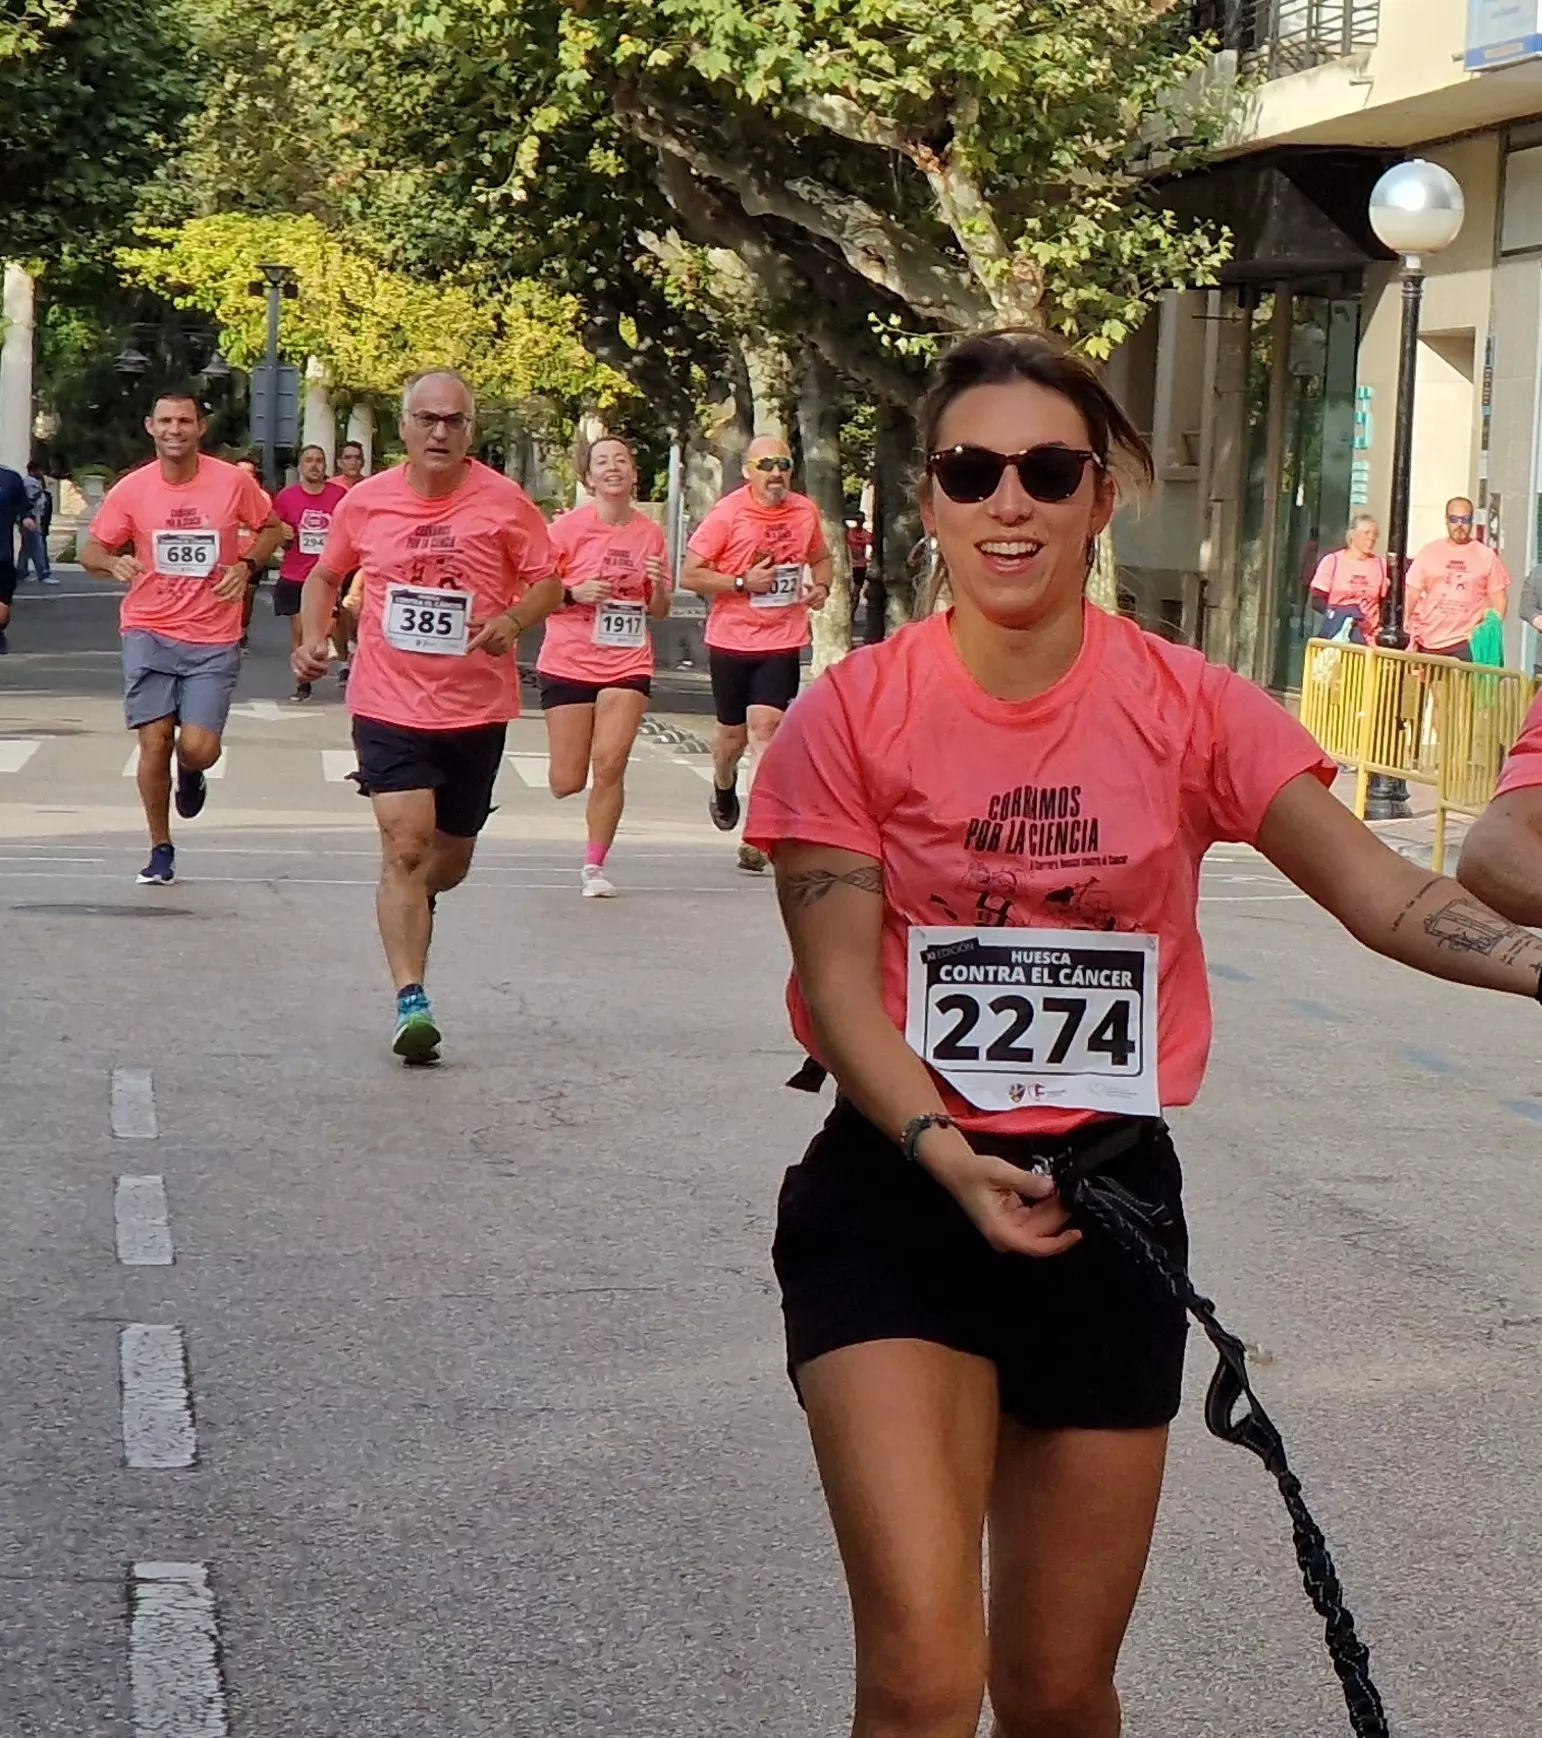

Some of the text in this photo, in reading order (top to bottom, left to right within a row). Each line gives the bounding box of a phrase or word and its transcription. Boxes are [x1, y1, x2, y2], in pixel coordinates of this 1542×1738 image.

[167, 546, 207, 563] 686
[769, 577, 798, 595] 022
[400, 607, 452, 635] 385
[602, 615, 642, 634] 1917
[964, 817, 1099, 857] POR LA CIENCIA
[1010, 949, 1072, 967] HUESCA
[938, 964, 1134, 988] CONTRA EL CÁNCER
[932, 993, 1136, 1067] 2274
